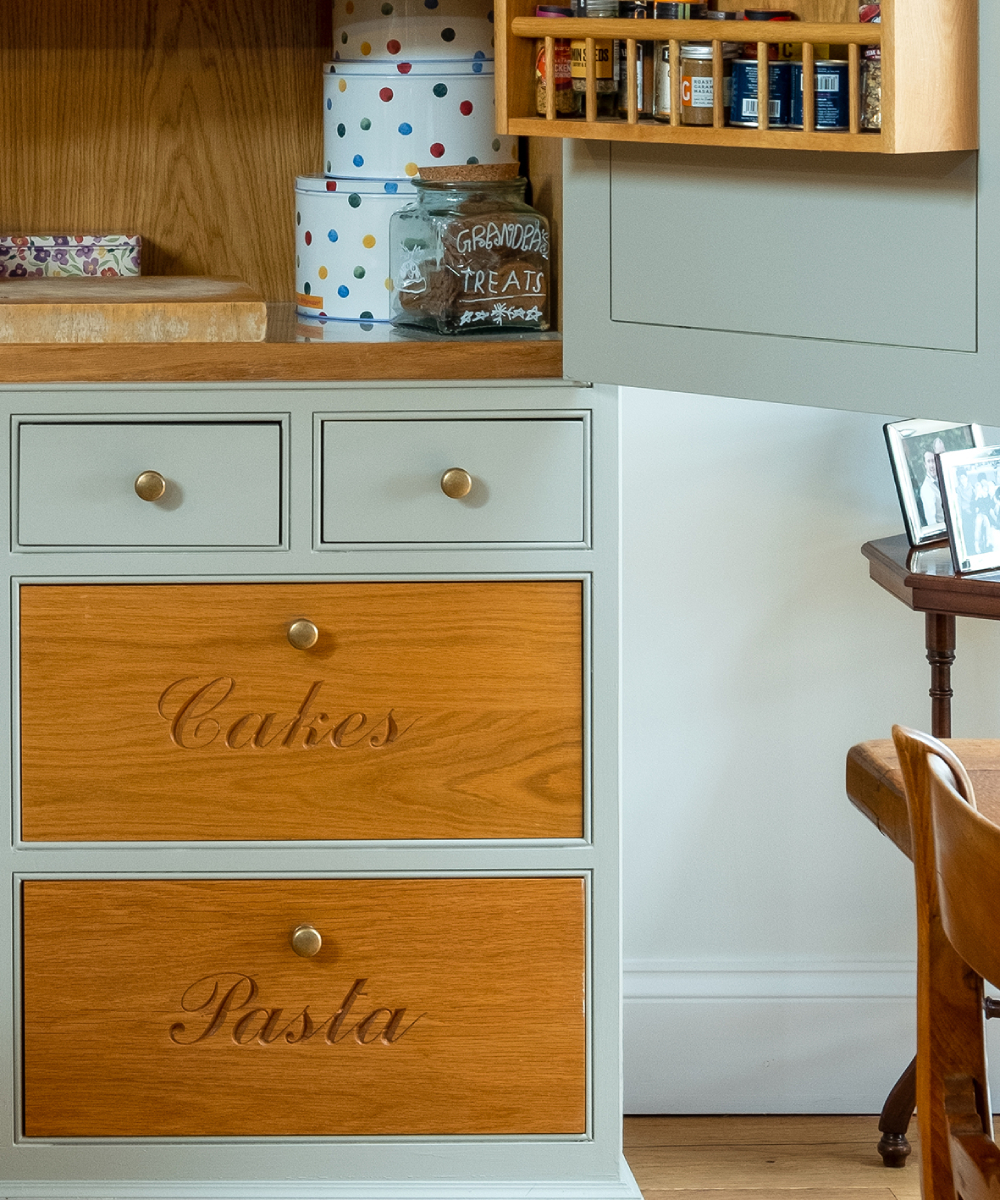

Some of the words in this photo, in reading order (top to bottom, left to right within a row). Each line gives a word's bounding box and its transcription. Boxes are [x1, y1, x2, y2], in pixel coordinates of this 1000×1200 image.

[583, 48, 609, 62] SEDS
[456, 221, 550, 256] GRANDPA'S
[461, 269, 546, 295] TREATS
[158, 676, 422, 751] Cakes
[169, 972, 428, 1047] Pasta
